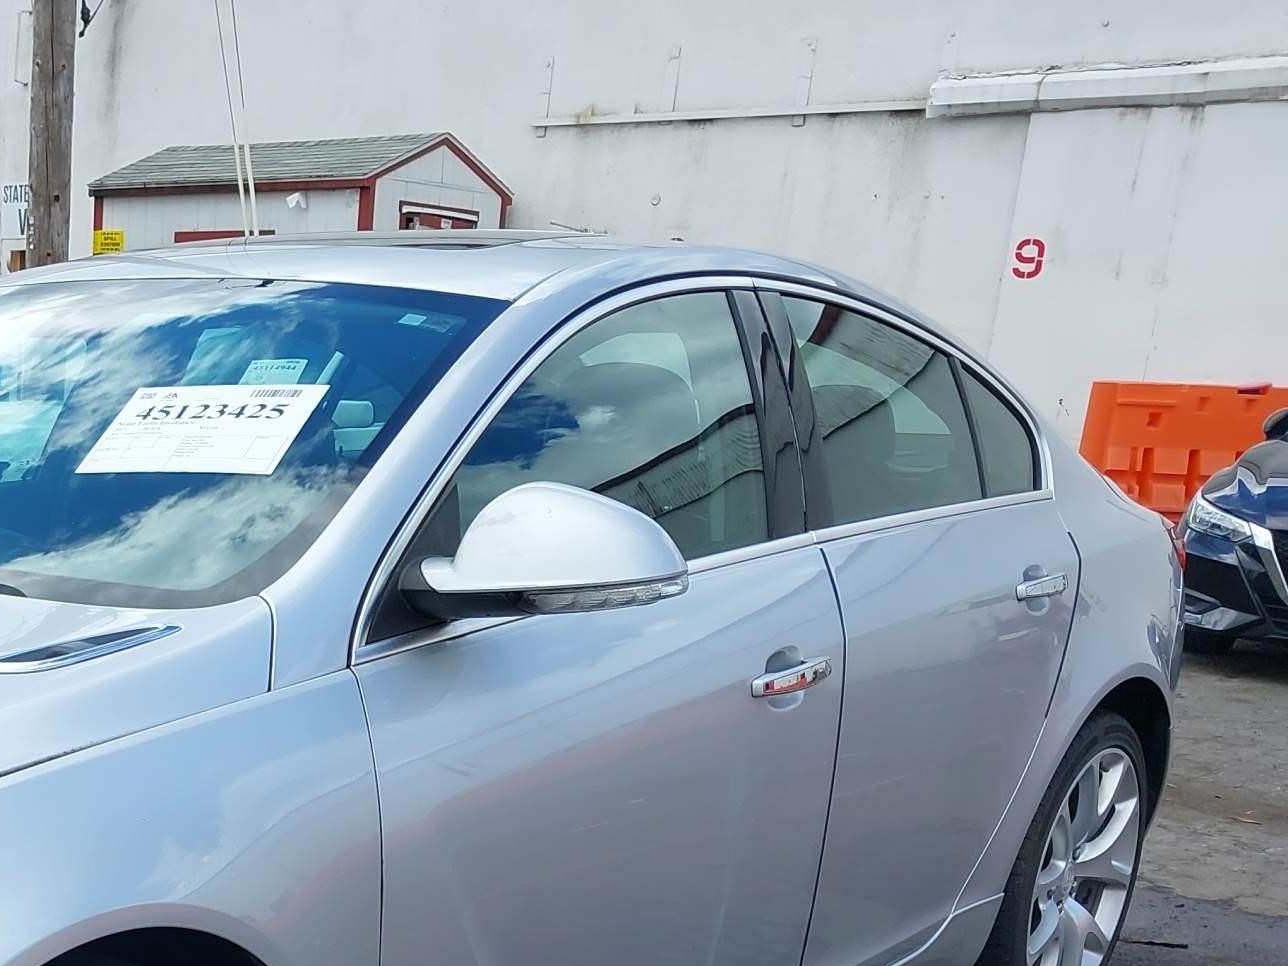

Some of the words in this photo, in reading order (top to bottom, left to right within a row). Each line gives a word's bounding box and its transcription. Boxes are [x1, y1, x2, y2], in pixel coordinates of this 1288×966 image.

[3, 184, 29, 204] STATE
[1012, 238, 1046, 279] 9
[135, 403, 290, 421] 45123425
